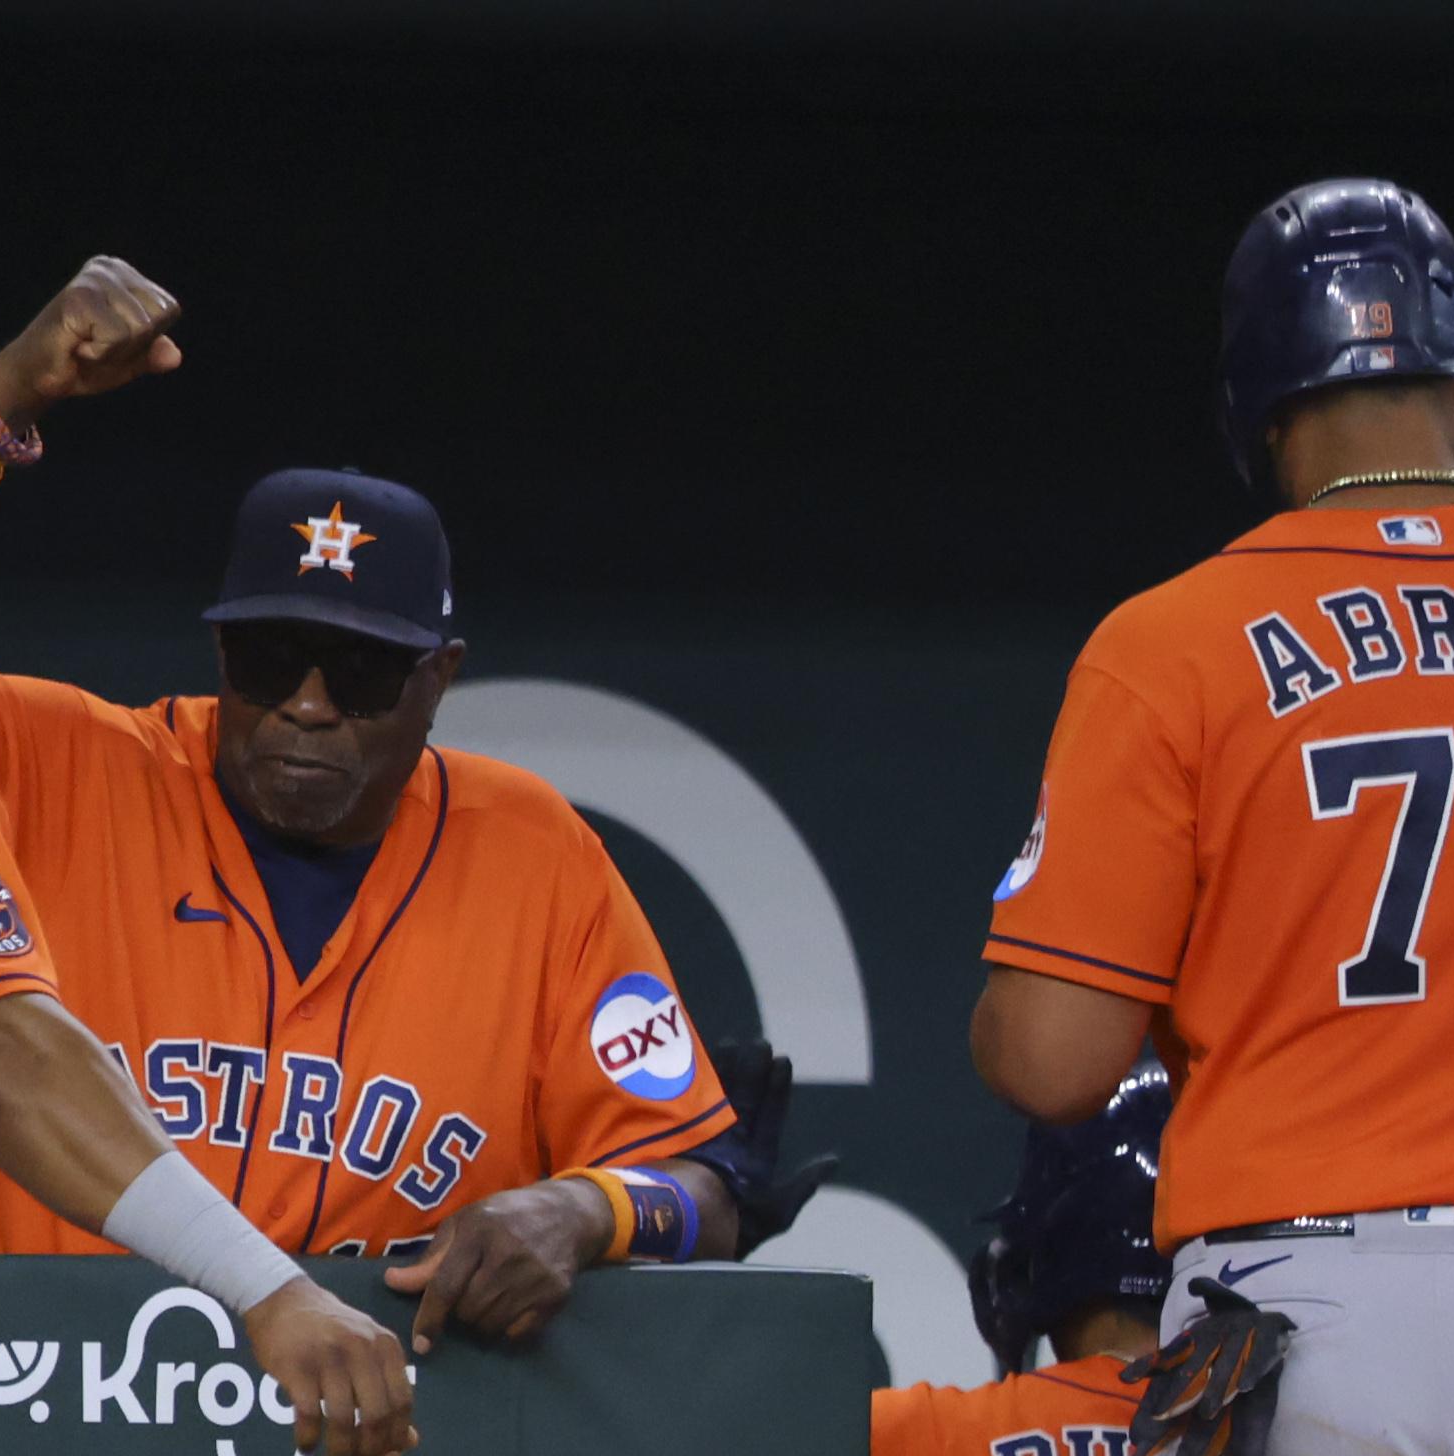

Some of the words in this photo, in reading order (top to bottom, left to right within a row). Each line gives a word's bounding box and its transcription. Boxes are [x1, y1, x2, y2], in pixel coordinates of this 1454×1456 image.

[299, 516, 361, 571] H
[597, 1004, 682, 1072] OXY
[105, 1037, 488, 1211] STROS
